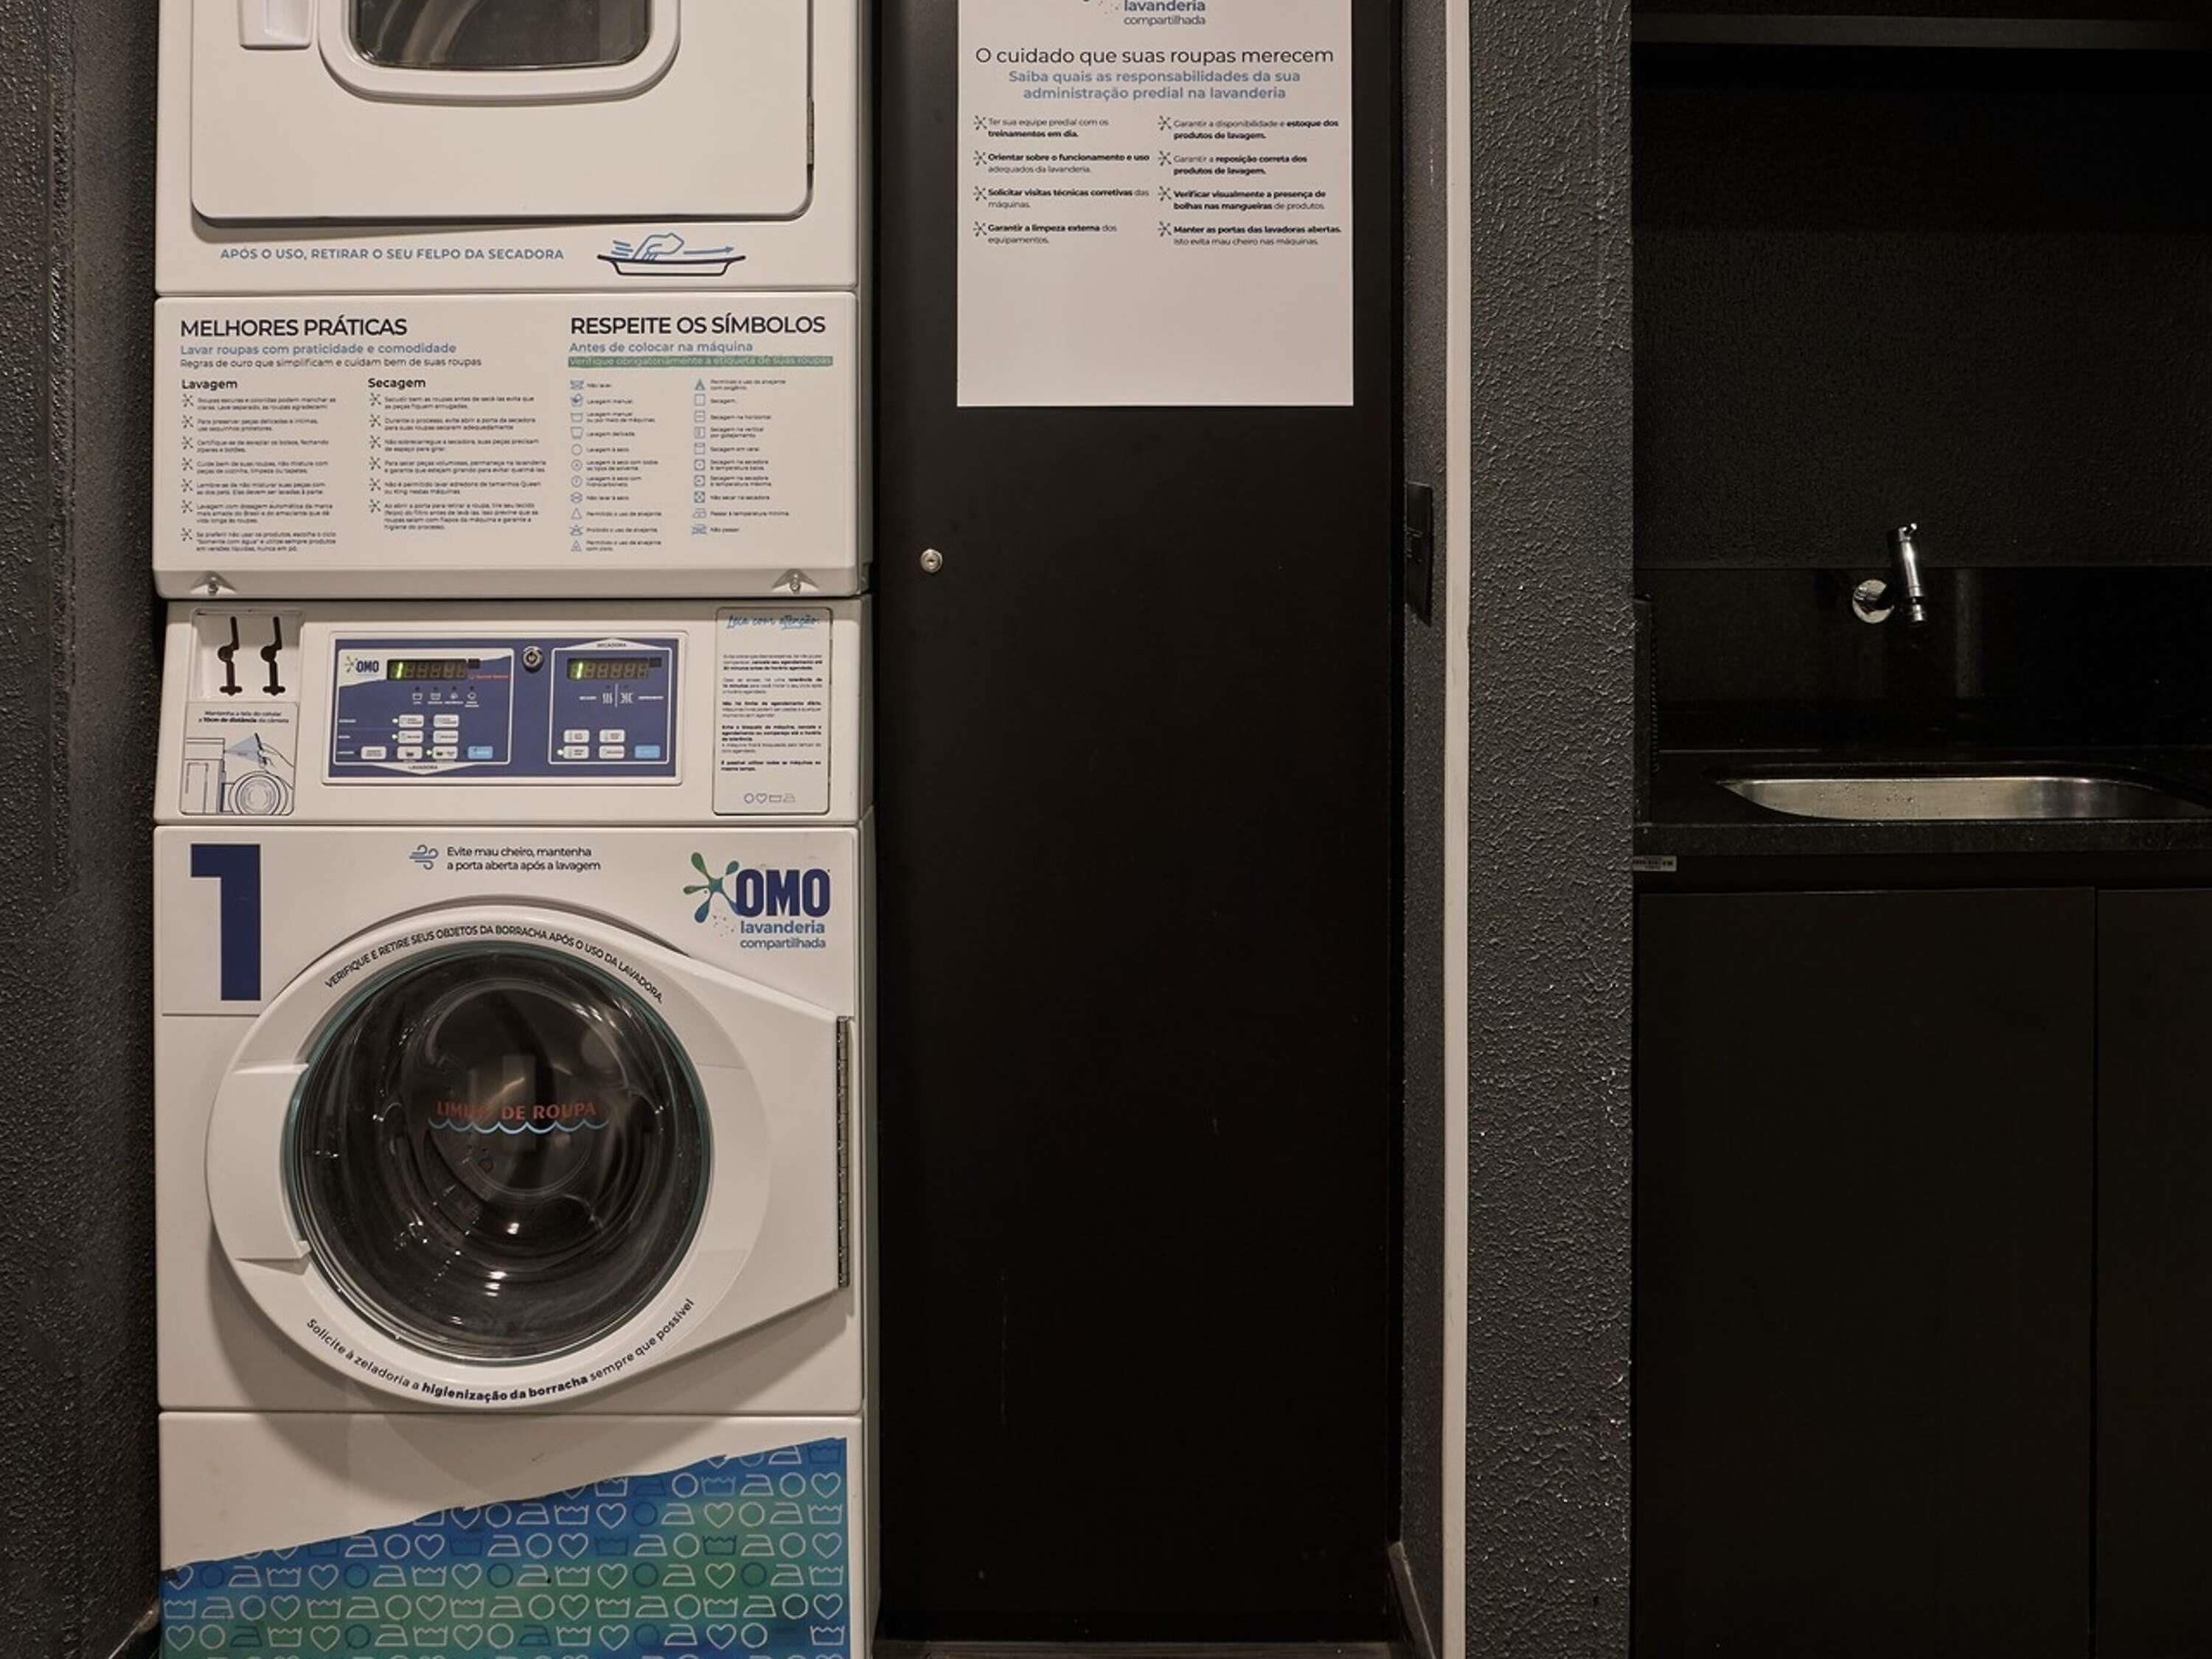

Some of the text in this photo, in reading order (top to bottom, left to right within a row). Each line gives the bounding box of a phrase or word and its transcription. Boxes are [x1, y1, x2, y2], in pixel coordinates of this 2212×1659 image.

[1124, 0, 1206, 11] lavanderia
[1123, 15, 1206, 26] compartilhada
[975, 48, 1333, 66] O cuidado que suas roupas merecem
[1009, 70, 1301, 84] Saiba quais as responsabilidades da sua
[1023, 86, 1286, 100] administração predial na lavanderia
[1173, 131, 1267, 140] produtos de lavagem.
[1173, 155, 1207, 163] Garantir
[1215, 156, 1258, 164] reposição
[1291, 155, 1307, 163] dos
[1227, 167, 1266, 175] lavagem.
[1133, 189, 1150, 197] das
[1032, 224, 1066, 232] limpeza
[1102, 224, 1117, 232] dos
[1247, 226, 1263, 234] das
[1265, 226, 1306, 234] lavadoras
[220, 248, 564, 260] APÓS O USO, RETIRAR O SEU FELPO DA SECADORA
[181, 315, 407, 337] MELHORES PRÁTICAS
[571, 313, 826, 334] RESPEITE OS SÍMBOLOS
[181, 343, 456, 355] Lavar roupas com praticidade e comodidade
[569, 341, 753, 352] Antes de colocar na máquina
[180, 359, 214, 369] Regras
[254, 360, 274, 368] que
[276, 358, 334, 367] simplificam
[344, 358, 382, 367] cuidam
[383, 358, 406, 366] bem
[408, 358, 422, 366] de
[448, 359, 481, 367] roupas
[181, 380, 237, 391] Lavagem
[368, 378, 426, 389] Secagem
[355, 660, 379, 673] OMO
[447, 846, 592, 858] Evite mau cheiro, mantenha
[447, 860, 601, 873] a porta aberta após a lavagem
[736, 868, 830, 918] OMO
[190, 843, 261, 1001] 1
[740, 919, 826, 934] lavanderia
[740, 937, 826, 950] compartilhada
[324, 953, 372, 988] VERIFIQUE
[370, 950, 379, 960] E
[378, 938, 410, 957] RETIRE
[410, 931, 435, 945] SEUS
[437, 925, 479, 939] OBJETOS
[479, 925, 494, 935] DA
[495, 925, 547, 939] BORRACHA
[549, 933, 575, 947] APÓS
[574, 939, 584, 950] O
[584, 945, 604, 959] USO
[604, 953, 619, 967] DA
[501, 1105, 526, 1120] DE
[532, 1102, 597, 1119] ROUPA
[306, 1297, 695, 1403] Solicite à zeladoria a higienização da borracha sempre que possível
